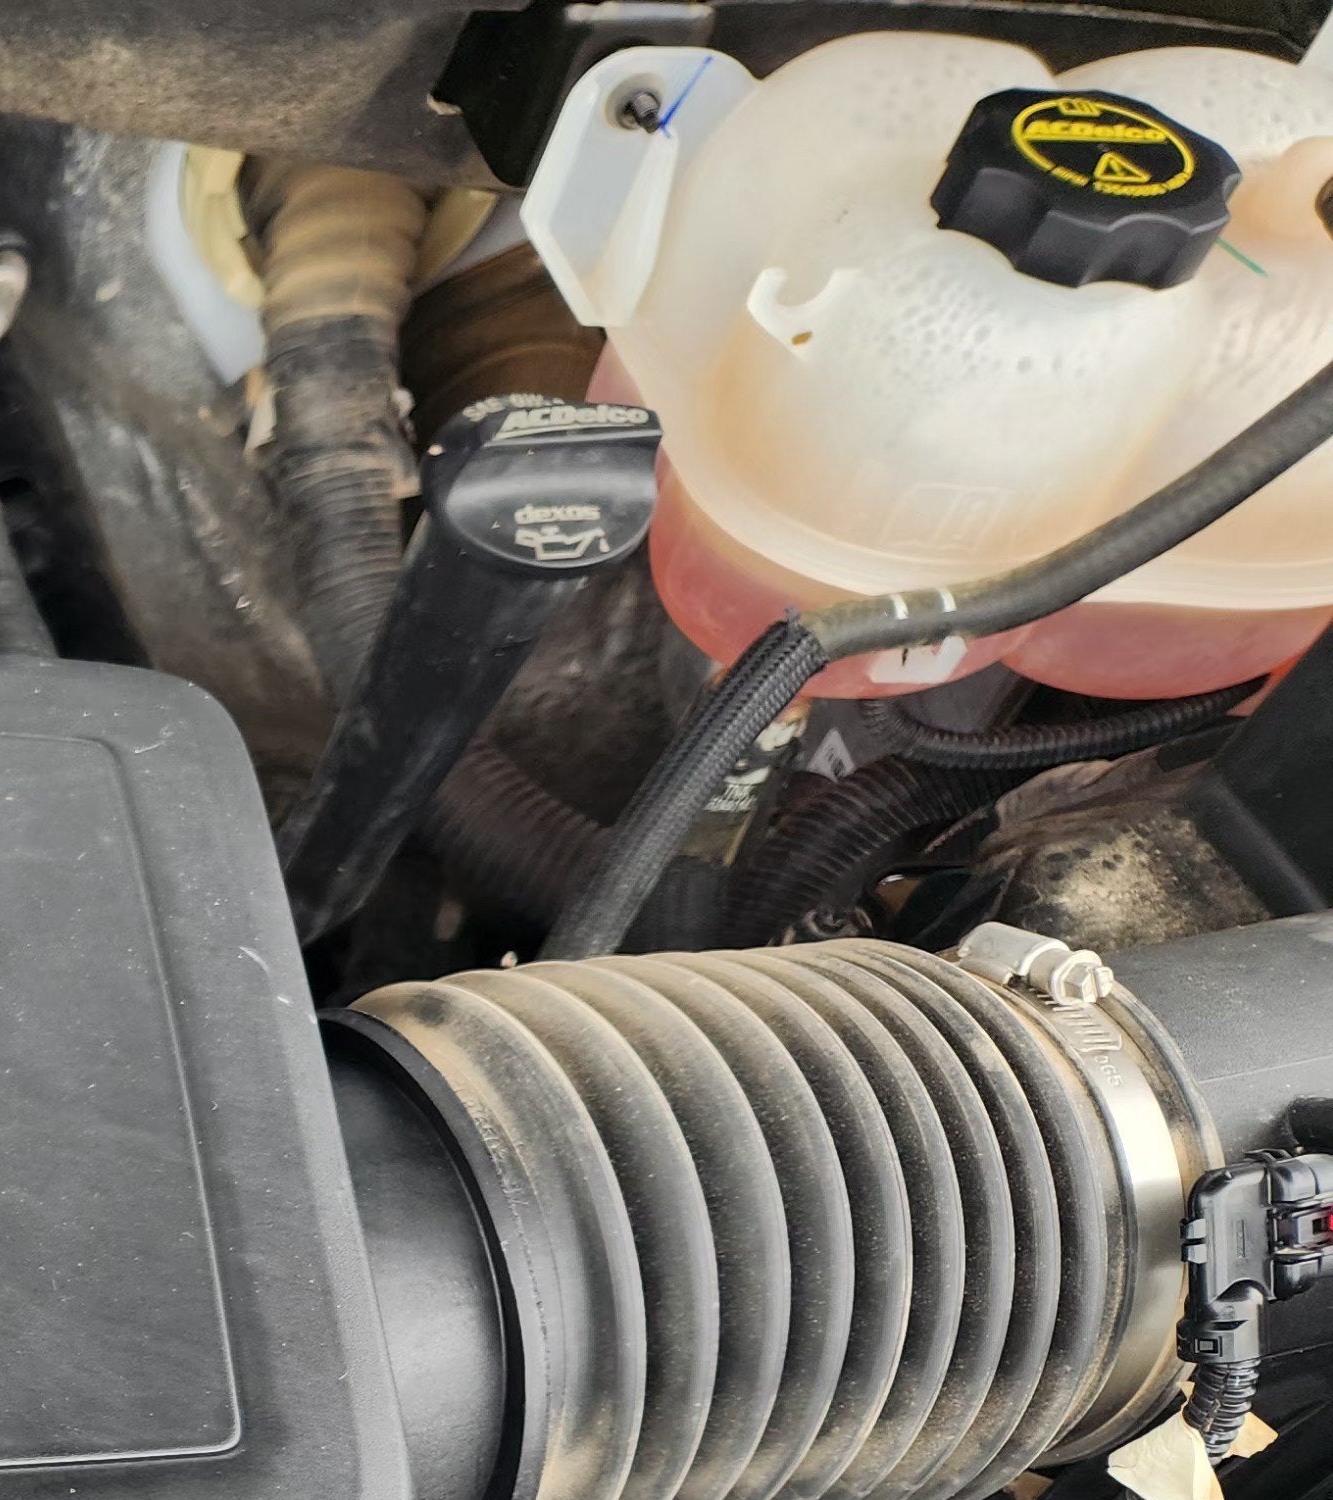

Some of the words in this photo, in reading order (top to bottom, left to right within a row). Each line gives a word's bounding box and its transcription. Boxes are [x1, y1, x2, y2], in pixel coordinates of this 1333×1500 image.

[1023, 119, 1167, 143] ACDelco
[498, 404, 650, 435] ACDelco
[514, 503, 601, 524] dexos
